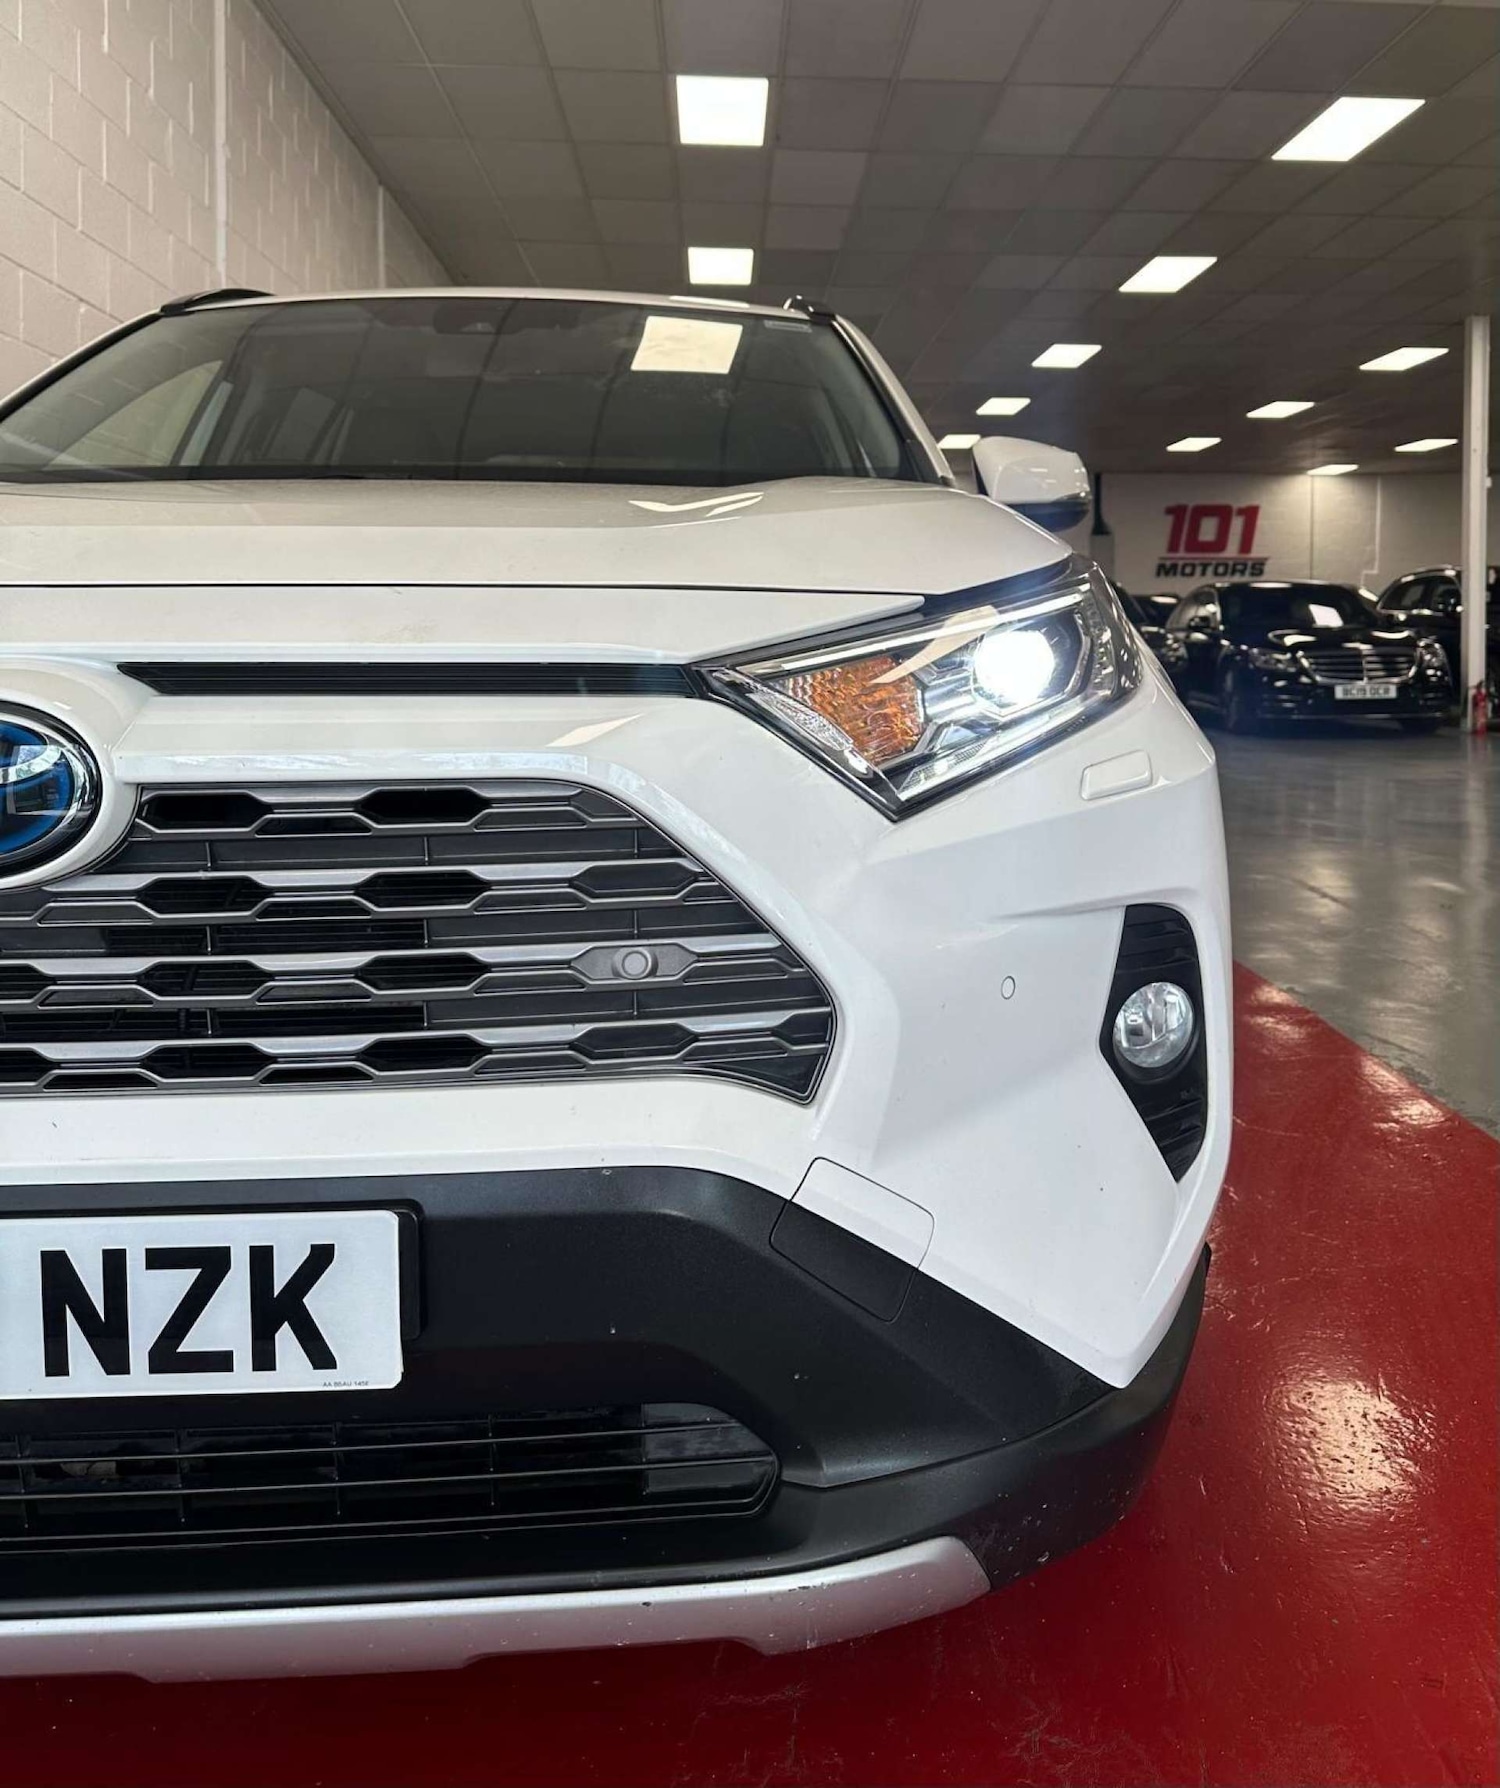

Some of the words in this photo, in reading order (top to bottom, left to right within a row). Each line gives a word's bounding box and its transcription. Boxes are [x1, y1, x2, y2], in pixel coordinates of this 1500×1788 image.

[1164, 504, 1260, 554] 101
[1155, 561, 1266, 578] MOTORS
[40, 1243, 338, 1377] NZK
